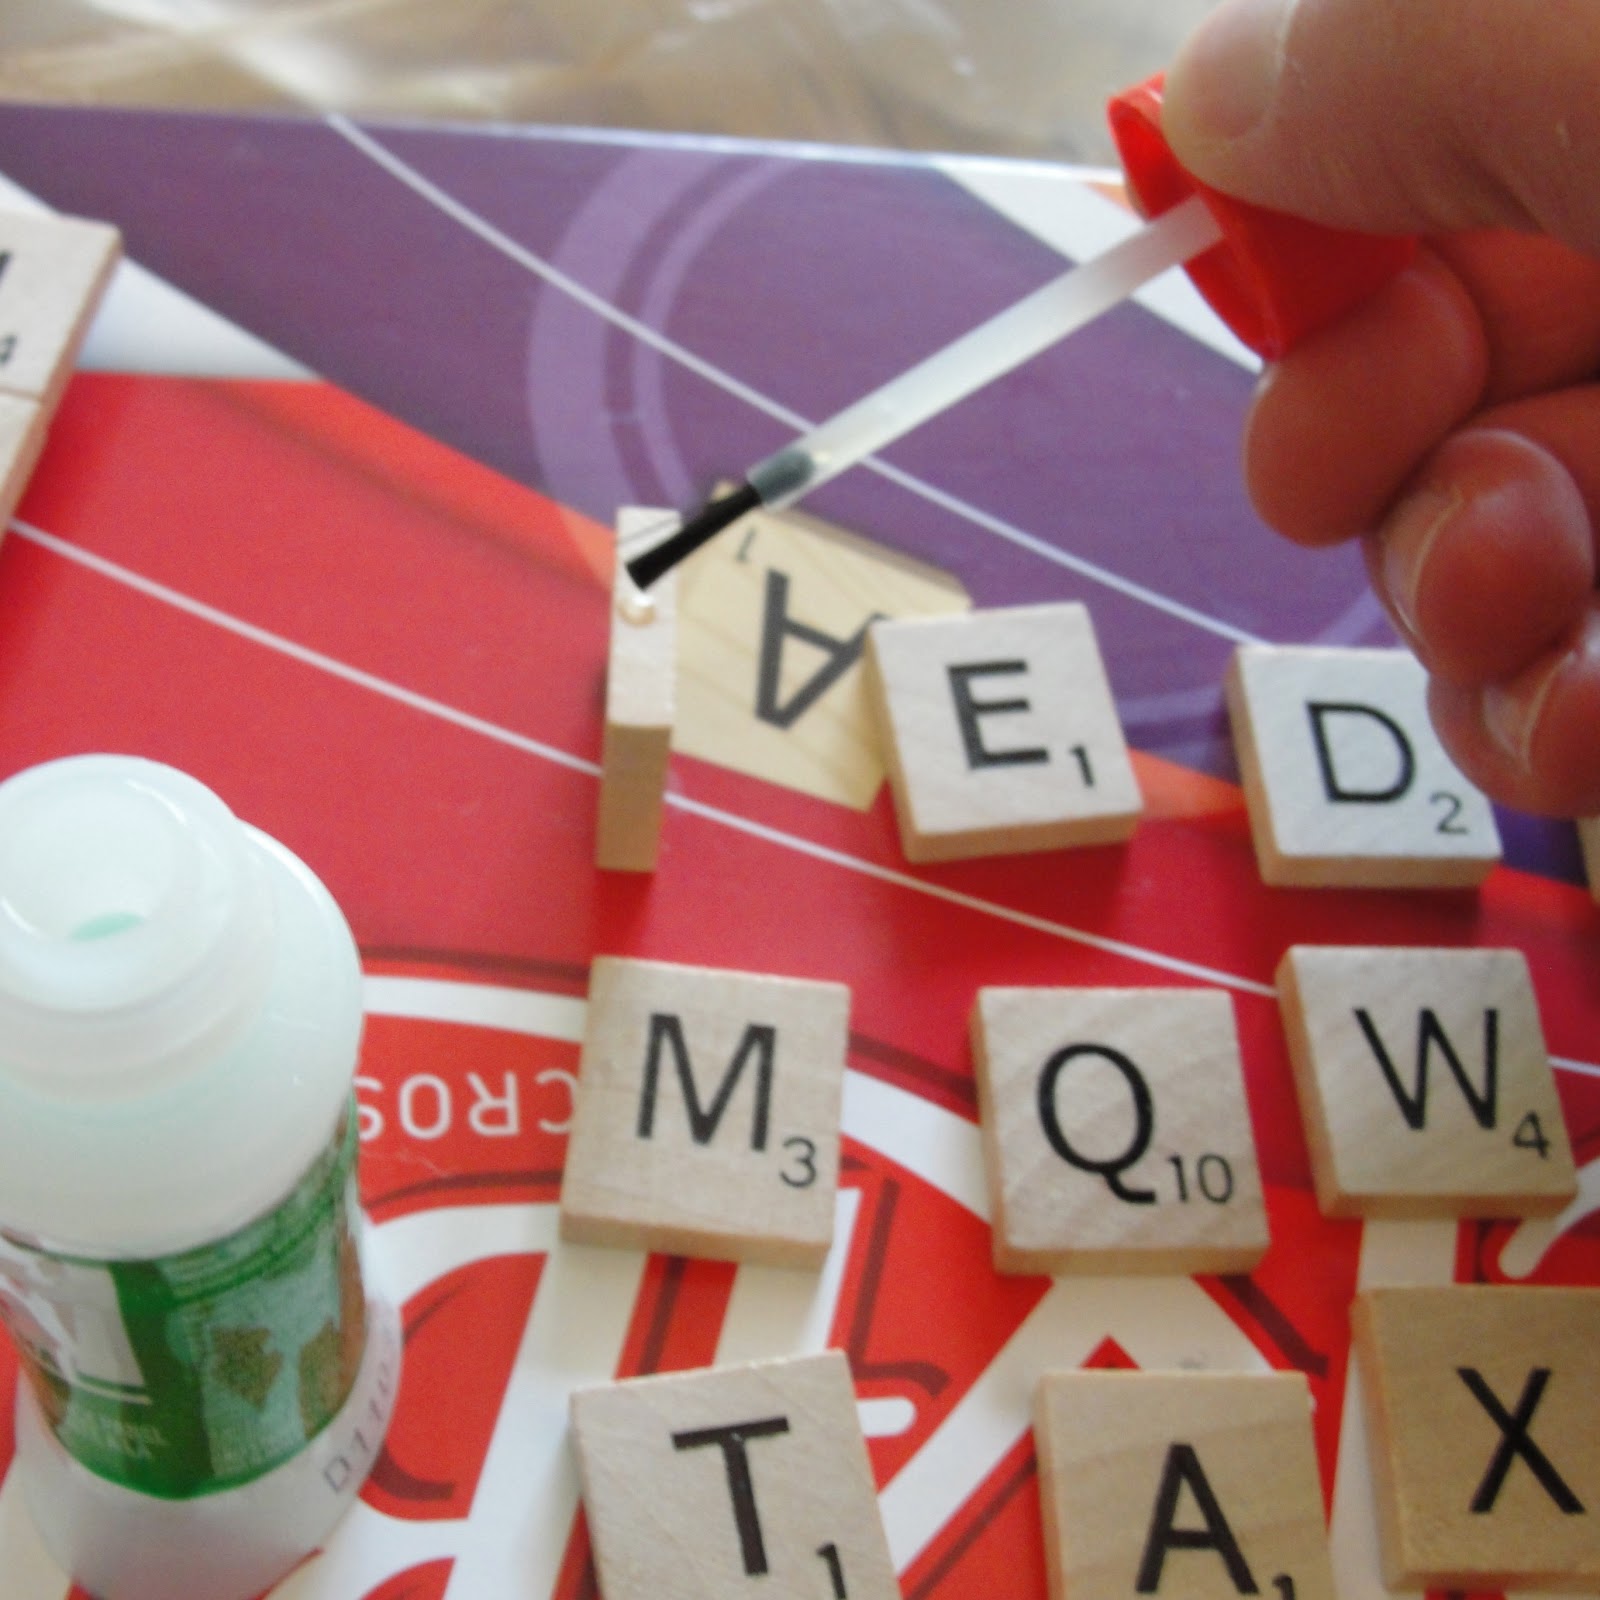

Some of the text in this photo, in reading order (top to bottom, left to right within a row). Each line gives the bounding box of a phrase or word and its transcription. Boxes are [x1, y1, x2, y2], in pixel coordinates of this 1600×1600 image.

[754, 568, 886, 731] A
[948, 660, 1094, 787] E 1
[1307, 702, 1468, 835] D 2
[638, 1013, 817, 1189] M 3
[1038, 1044, 1235, 1206] Q 10
[1355, 1008, 1551, 1160] W 4
[672, 1417, 789, 1576] T
[1457, 1368, 1585, 1515] X
[1135, 1444, 1259, 1596] A
